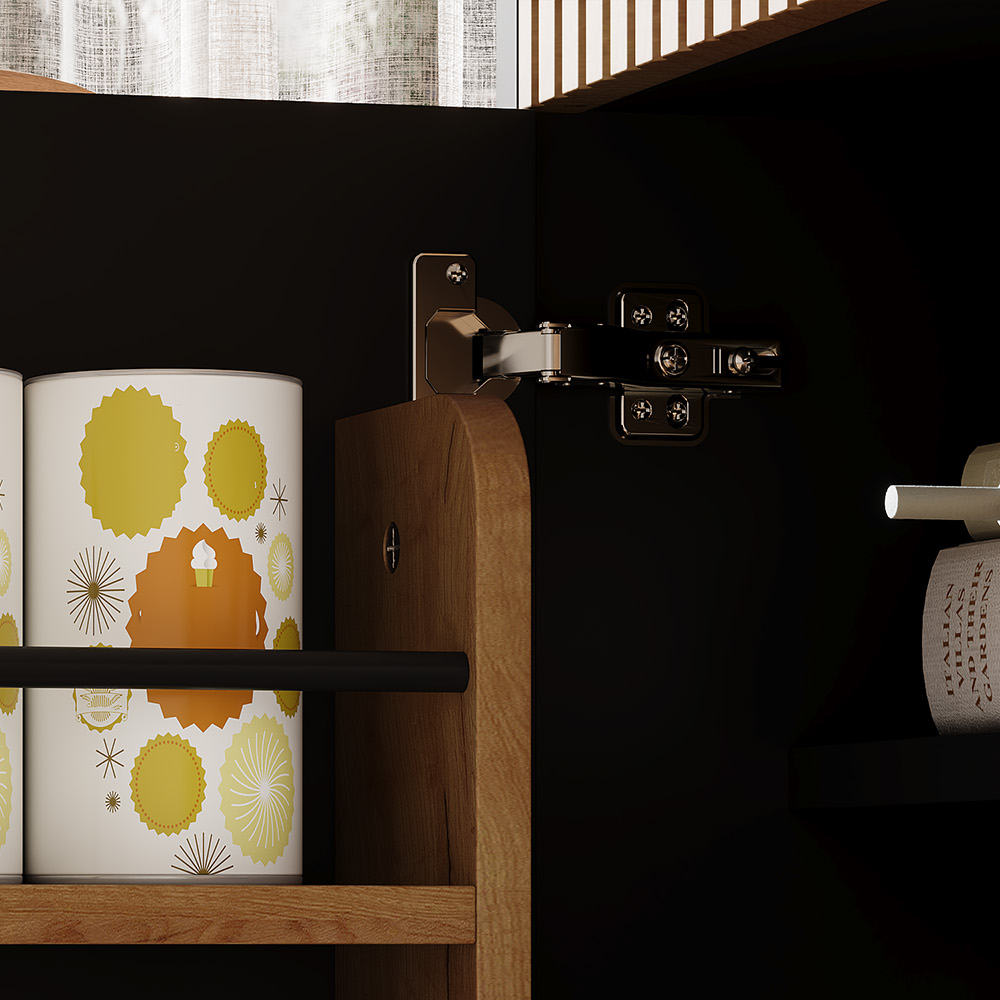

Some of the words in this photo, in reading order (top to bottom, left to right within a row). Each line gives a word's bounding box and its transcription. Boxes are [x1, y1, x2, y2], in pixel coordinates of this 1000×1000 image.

[942, 583, 955, 696] ITALIAN
[955, 588, 966, 688] VILLAS
[966, 560, 984, 649] THEIR
[979, 568, 994, 702] GARDENS
[967, 655, 984, 712] AND
